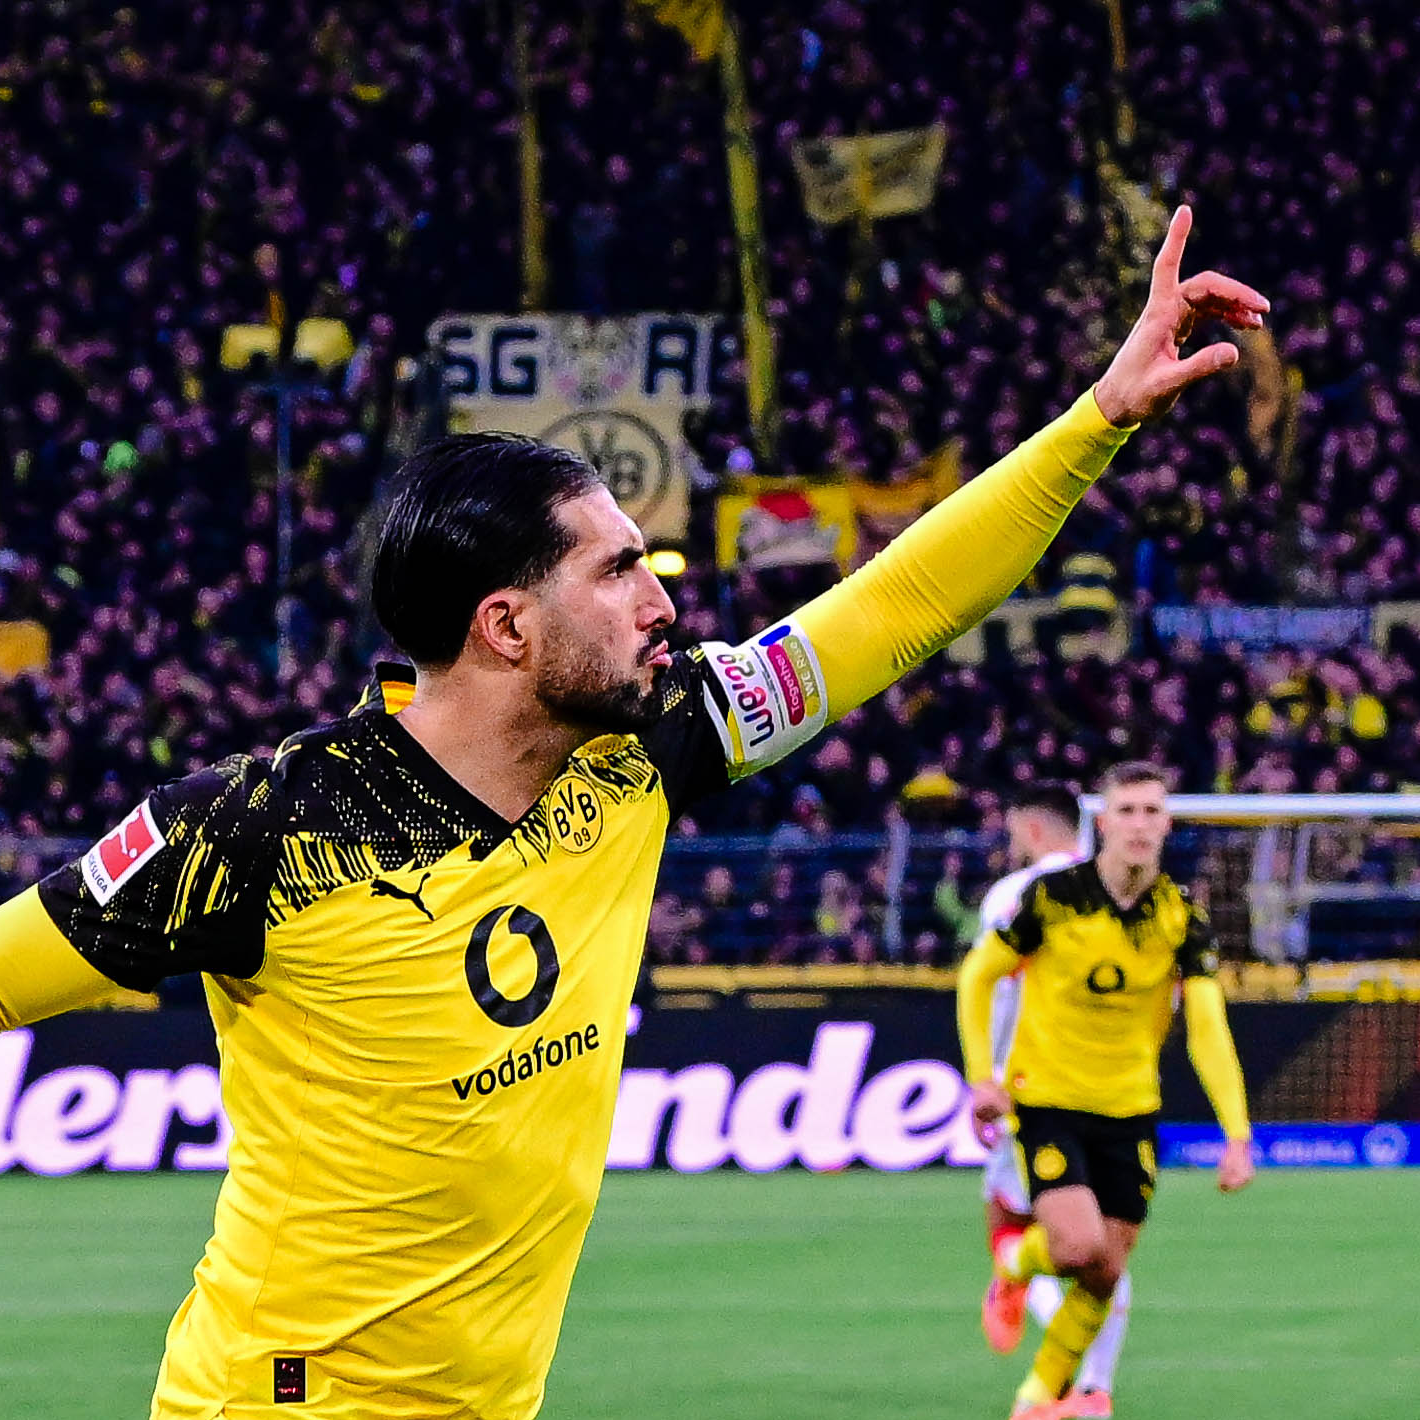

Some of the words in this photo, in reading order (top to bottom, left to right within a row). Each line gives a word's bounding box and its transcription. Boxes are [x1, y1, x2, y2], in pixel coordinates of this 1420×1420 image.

[439, 326, 537, 395] SG
[579, 422, 647, 499] VB
[775, 654, 801, 714] Together
[553, 781, 597, 839] BVB
[573, 826, 591, 847] 09
[452, 1023, 599, 1101] vodafone
